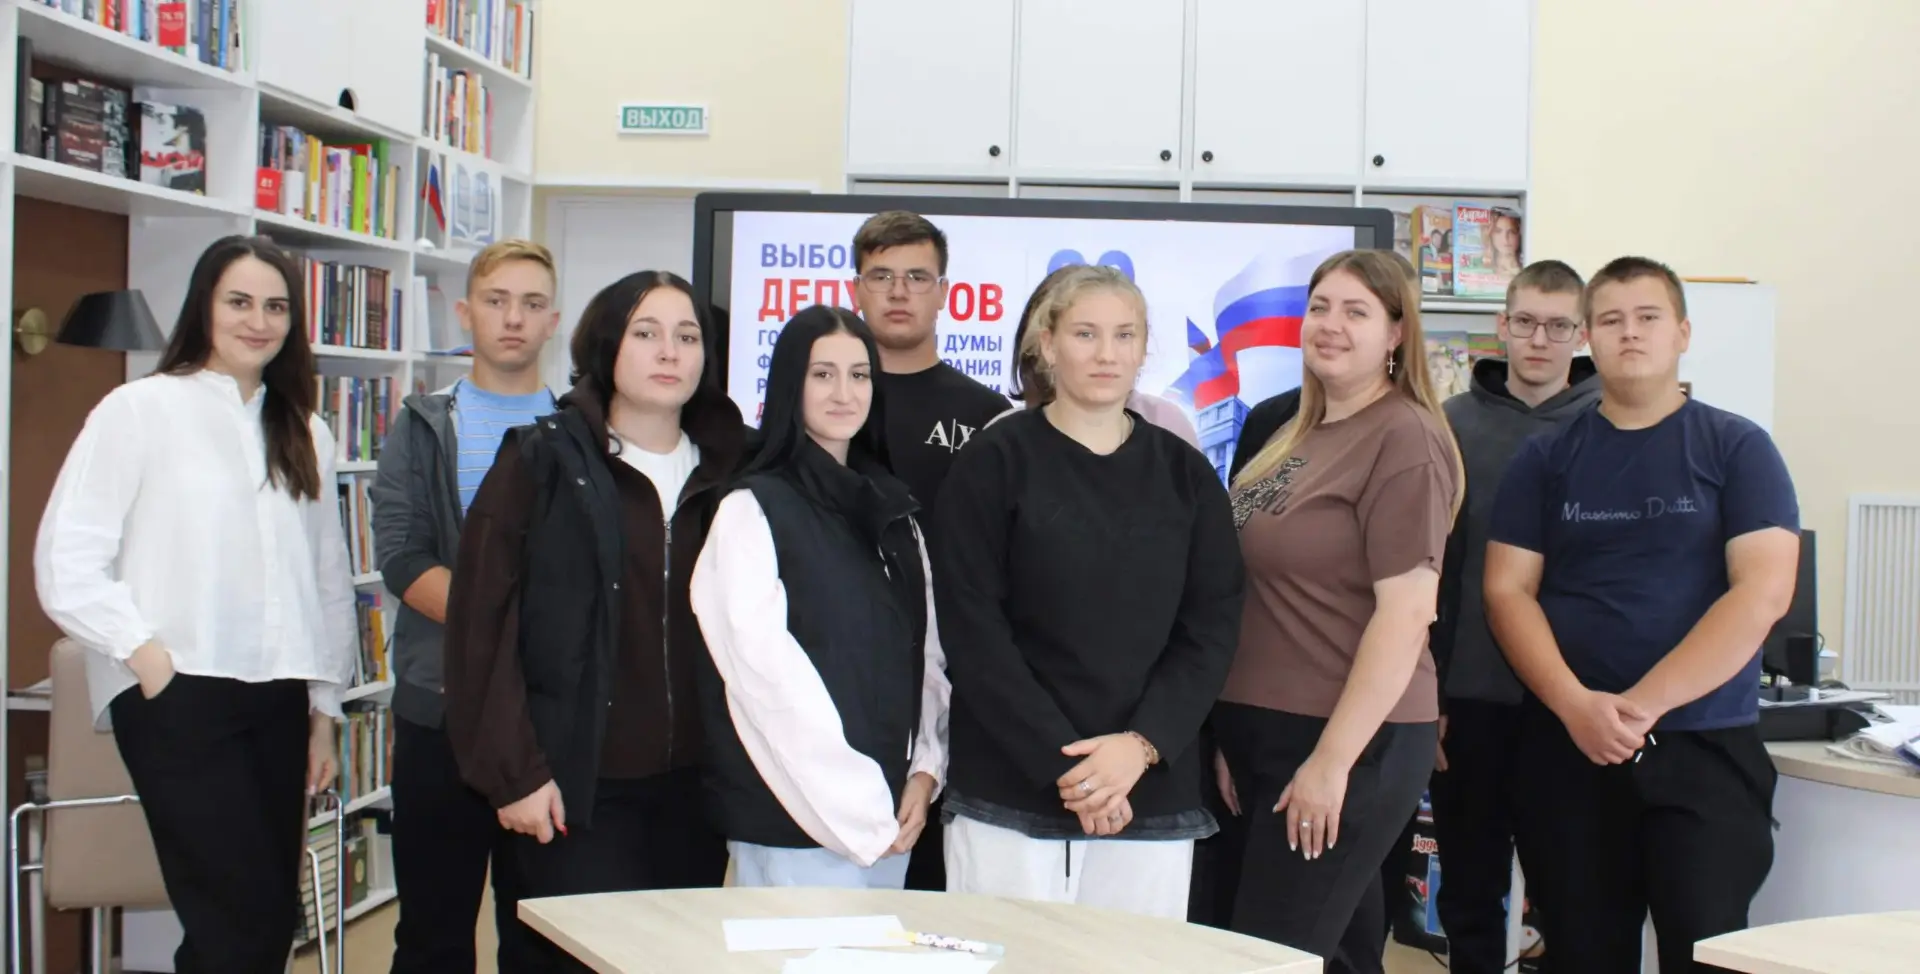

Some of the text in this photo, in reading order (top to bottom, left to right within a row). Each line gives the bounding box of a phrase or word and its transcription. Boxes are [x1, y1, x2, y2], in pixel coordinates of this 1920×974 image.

[626, 109, 700, 128] ВЫХОД
[760, 243, 856, 269] ВЫБО
[944, 334, 1002, 353] ДУМЫ
[1561, 496, 1699, 522] Massimo Dutti
